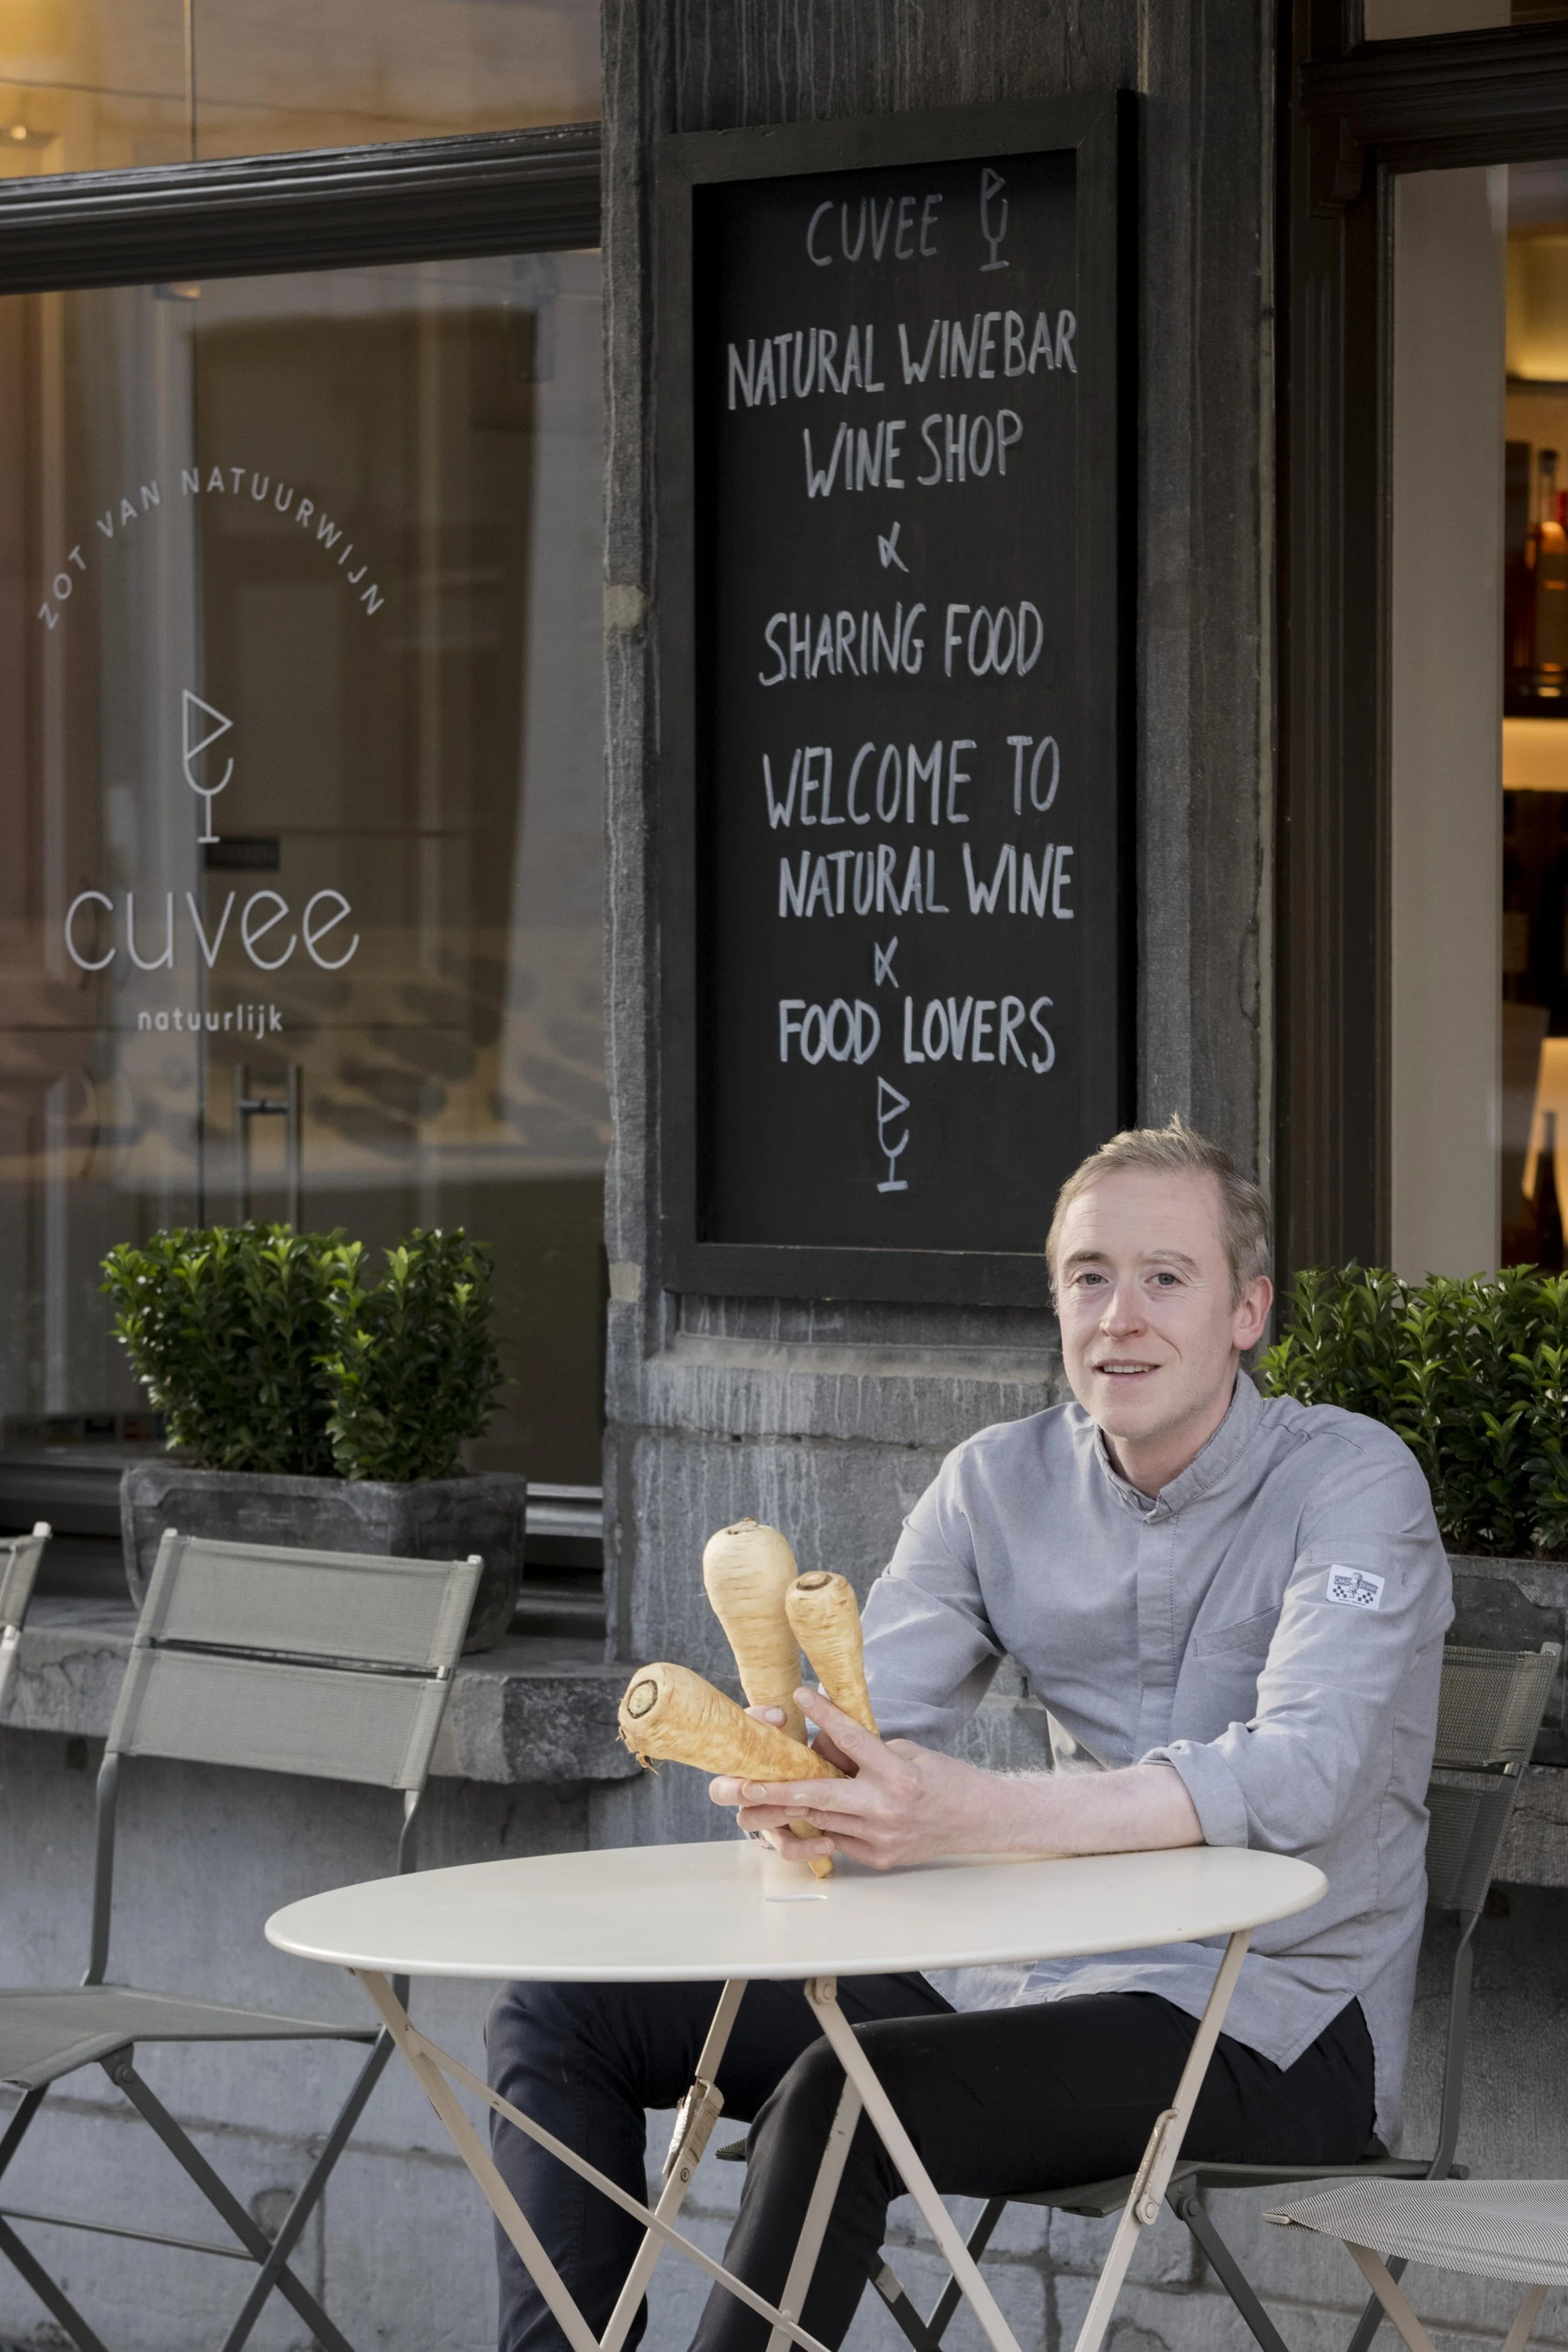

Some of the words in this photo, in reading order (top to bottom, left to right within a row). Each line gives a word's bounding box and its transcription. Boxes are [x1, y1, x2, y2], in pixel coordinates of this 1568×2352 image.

[807, 194, 943, 267] CUVEE
[728, 324, 884, 410] NATURAL
[899, 310, 1078, 384] WINEBAR
[803, 420, 906, 498] WINE
[918, 408, 1024, 486] SHOP
[38, 546, 86, 630] ZOT
[97, 480, 161, 538] VAN
[181, 466, 384, 616] NATUURWIJN
[759, 601, 927, 686] SHARING
[946, 601, 1044, 677] FOOD
[763, 740, 977, 829] WELCOME
[1006, 735, 1060, 815] TO
[779, 844, 950, 918] NATURAL
[963, 842, 1074, 919] WINE
[65, 889, 359, 970] cuvee
[137, 1004, 283, 1040] natuurlijk
[779, 998, 881, 1065] FOOD
[904, 995, 1055, 1074] LOVERS
